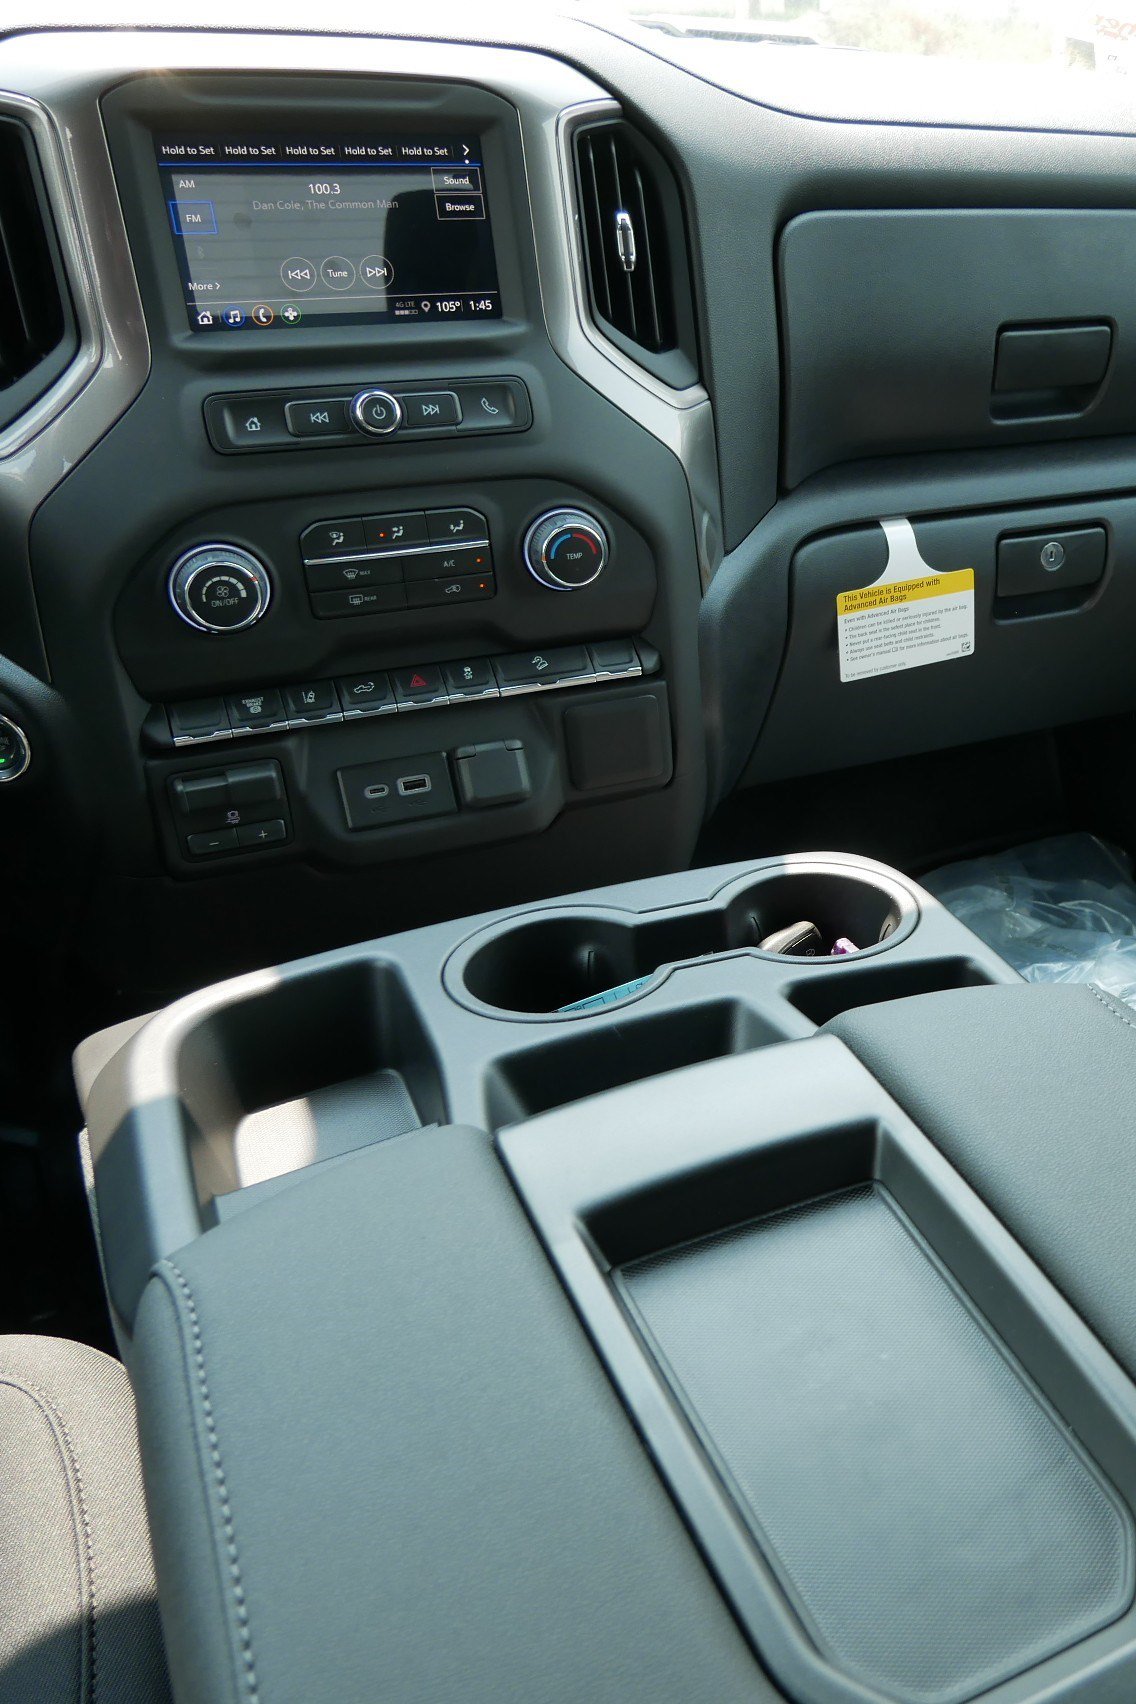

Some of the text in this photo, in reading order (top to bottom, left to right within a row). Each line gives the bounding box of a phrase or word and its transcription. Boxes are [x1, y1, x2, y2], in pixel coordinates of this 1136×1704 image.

[162, 146, 215, 155] Hold to Set
[225, 146, 276, 155] Hold to Set
[286, 146, 335, 155] Hold to Set
[344, 147, 392, 156] Hold to Set
[402, 147, 448, 156] Hold to Set
[179, 180, 195, 188] AM
[444, 176, 469, 185] Sound
[308, 183, 341, 195] 100.3
[252, 200, 398, 211] Dan Cole, The Common Man
[446, 203, 475, 211] Browse
[185, 214, 201, 223] FM
[327, 269, 348, 278] Tune
[188, 283, 213, 291] More
[469, 300, 492, 311] 1:45
[566, 552, 583, 560] TEMP
[443, 560, 456, 568] A/C
[843, 578, 940, 603] This Vehicle is Equipped with
[211, 597, 239, 608] ON/OFF
[843, 600, 876, 611] Advanced
[890, 593, 906, 603] Bags
